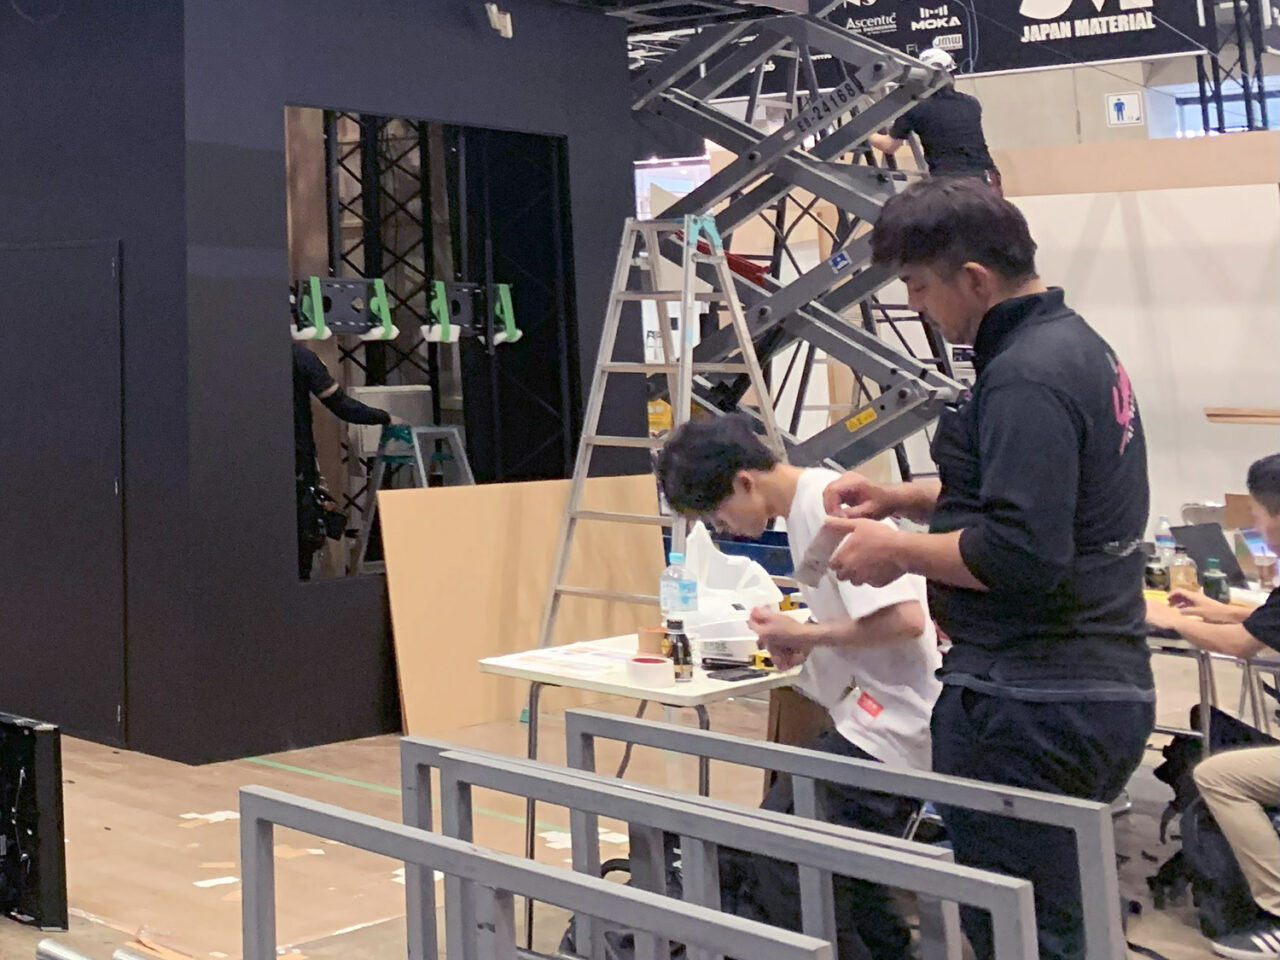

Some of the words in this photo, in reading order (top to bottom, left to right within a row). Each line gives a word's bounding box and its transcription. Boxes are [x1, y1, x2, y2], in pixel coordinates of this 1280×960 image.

[910, 16, 961, 31] MOKA
[1021, 20, 1072, 43] JAPAN
[1074, 11, 1157, 37] MATERIAL
